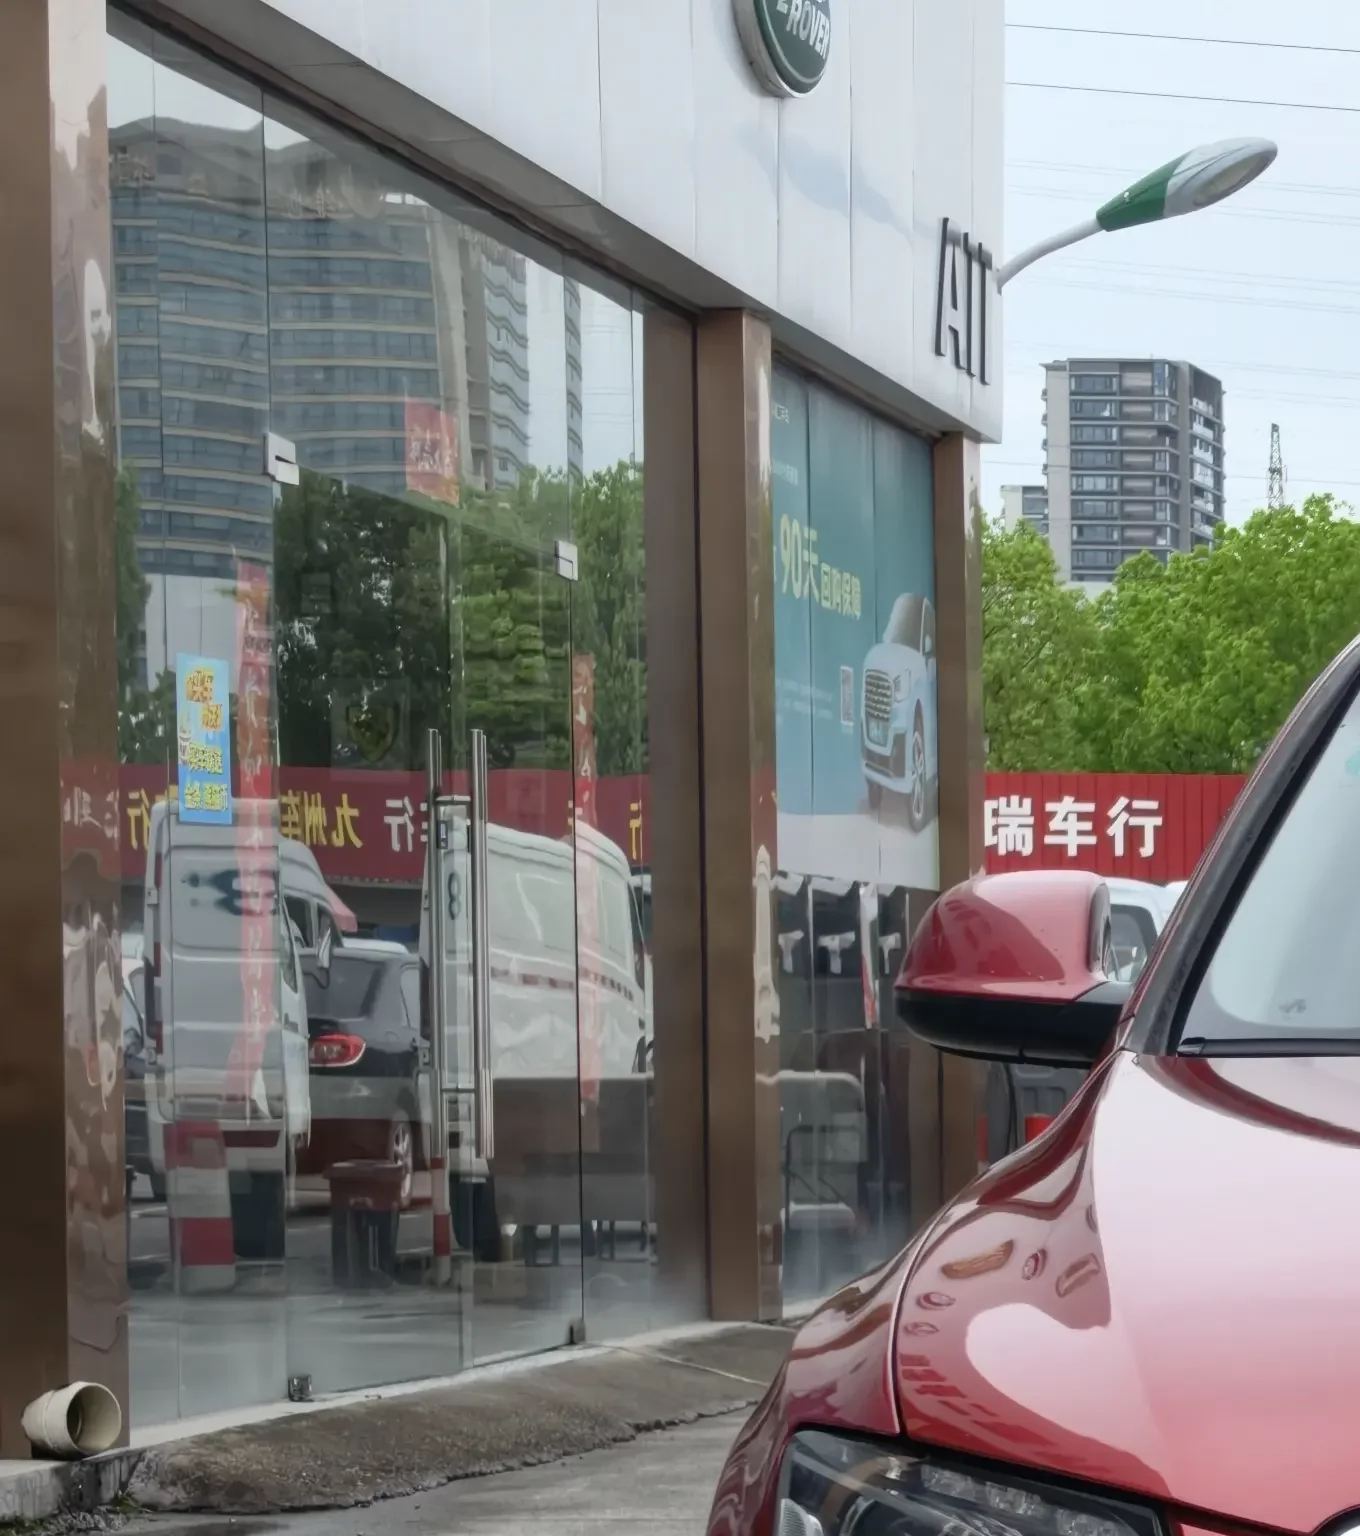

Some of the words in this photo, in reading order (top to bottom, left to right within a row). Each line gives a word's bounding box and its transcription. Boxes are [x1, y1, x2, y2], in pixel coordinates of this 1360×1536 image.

[785, 0, 830, 59] ROVER
[984, 795, 1163, 858] 瑞车行
